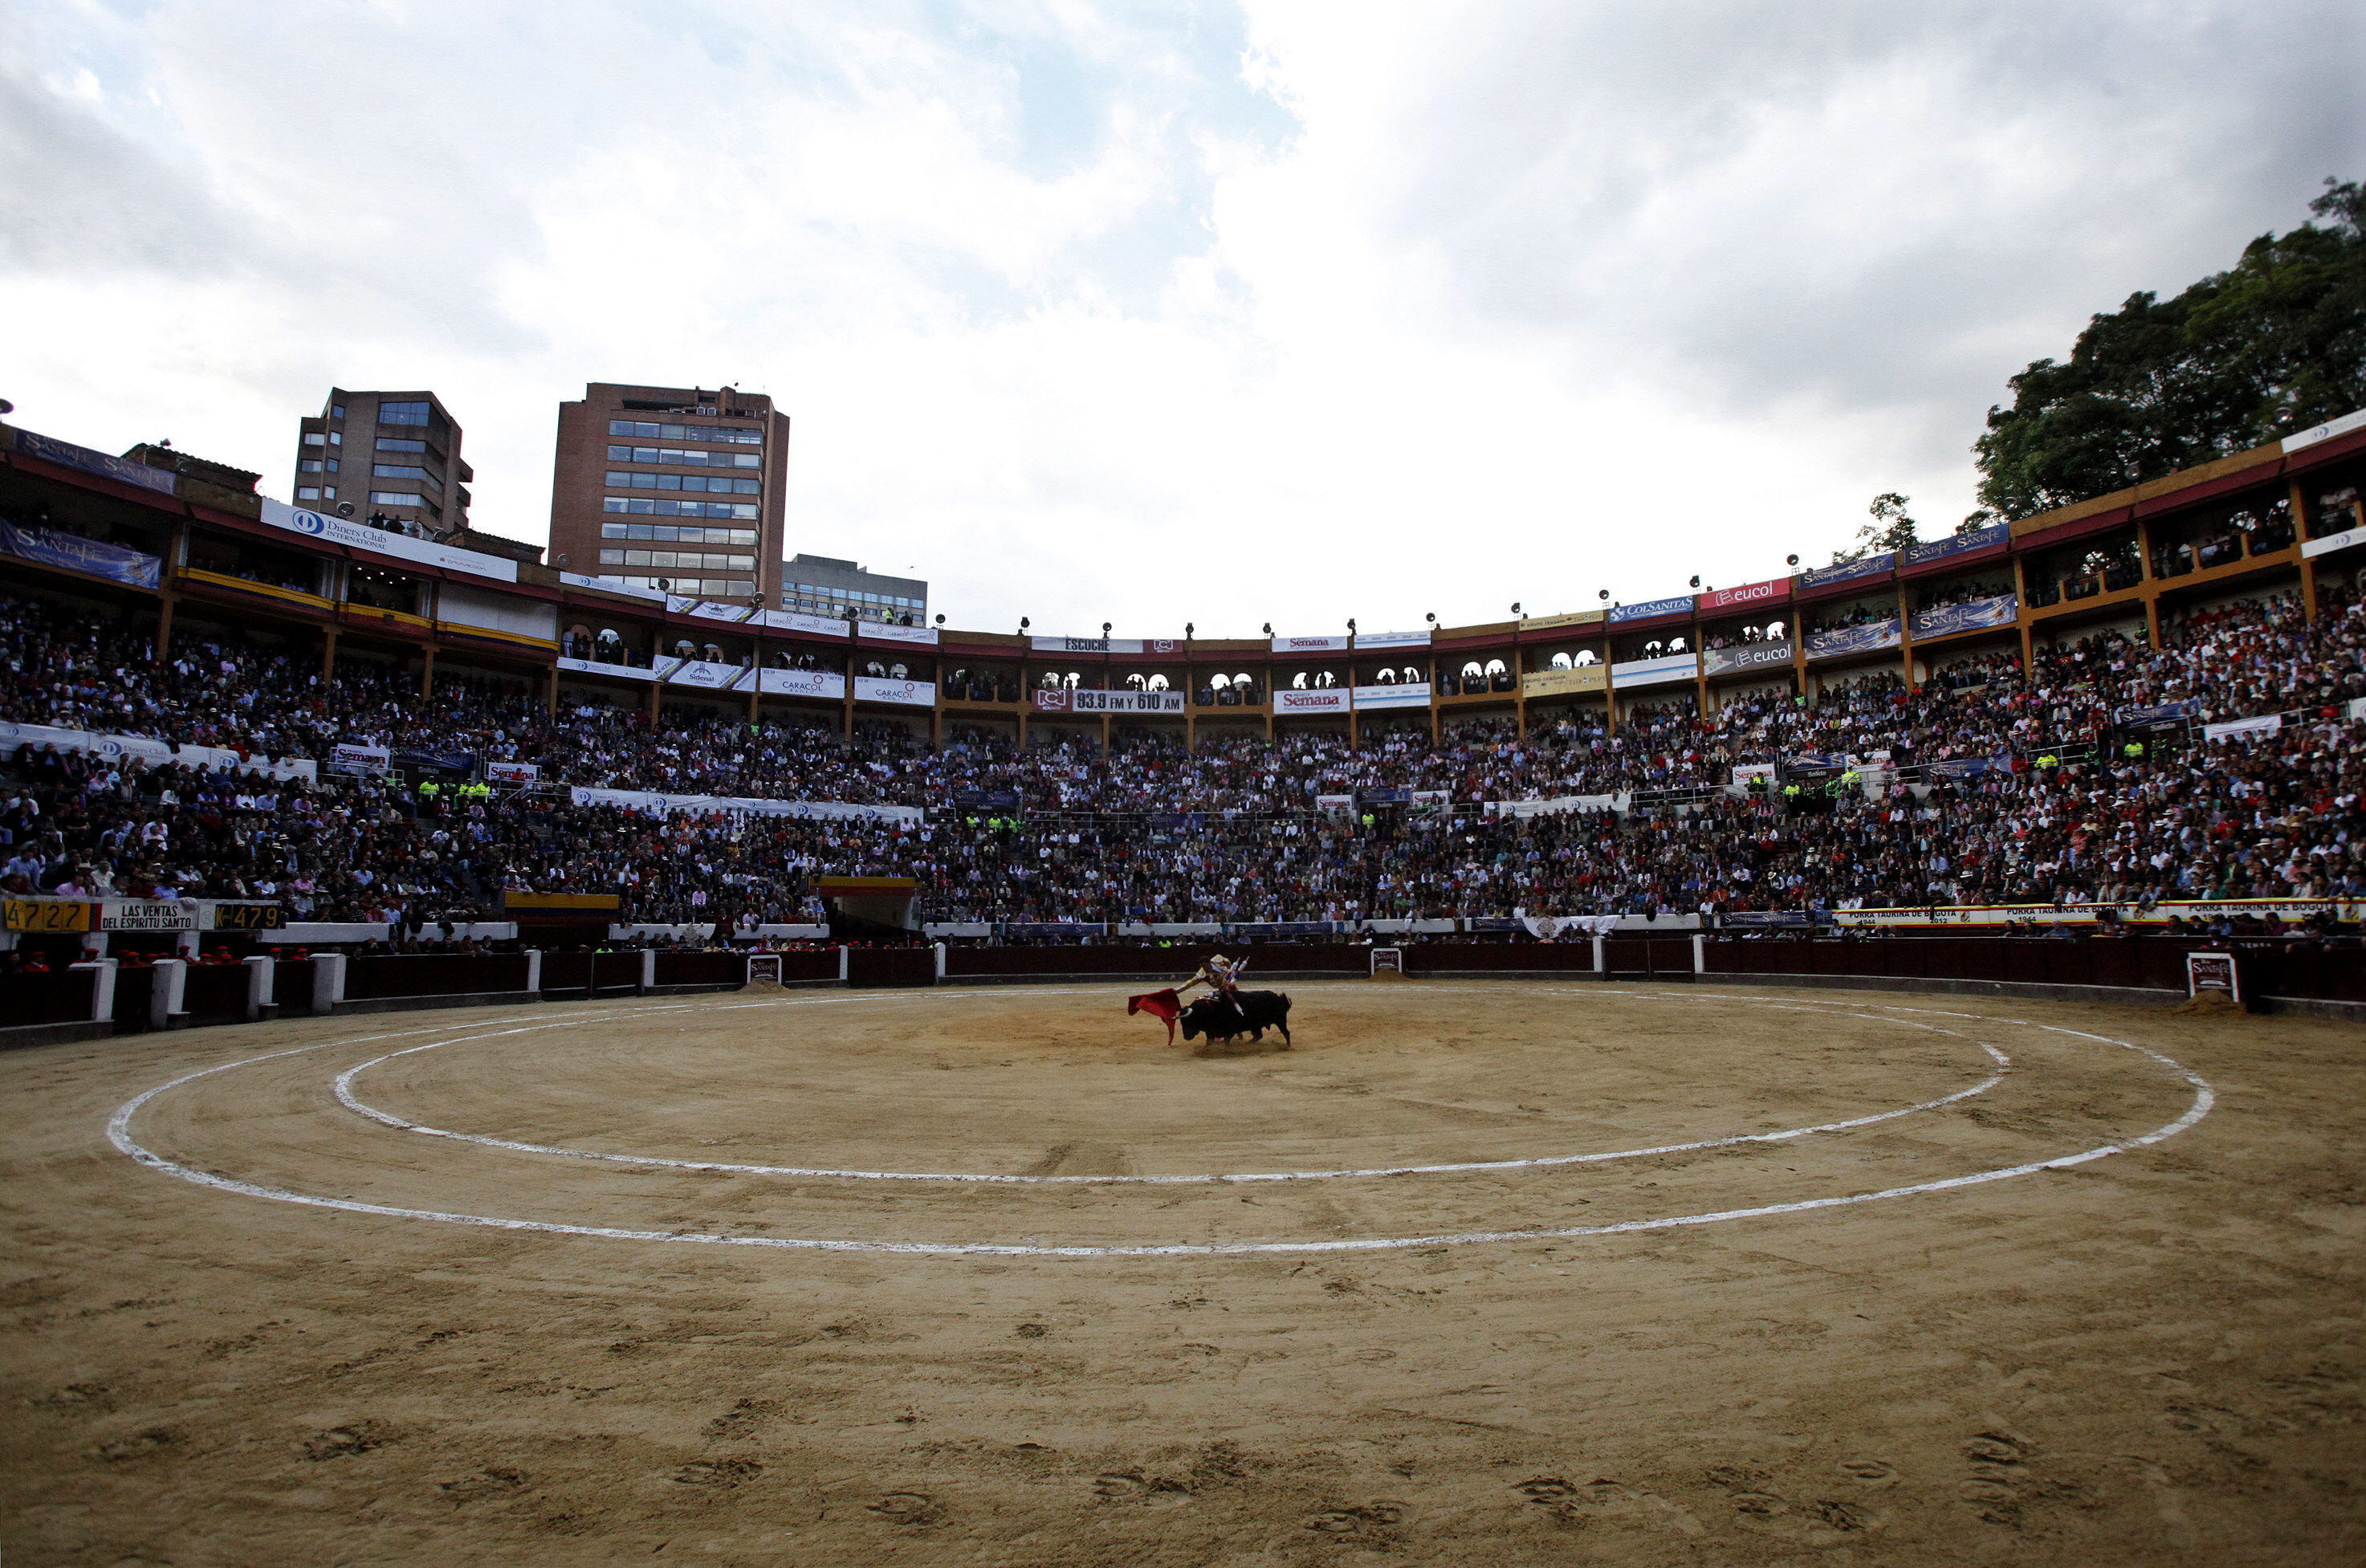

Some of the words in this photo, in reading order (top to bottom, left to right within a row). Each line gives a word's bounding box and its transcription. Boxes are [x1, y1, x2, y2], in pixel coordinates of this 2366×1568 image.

[327, 531, 385, 549] INTERNATIONAL
[363, 530, 387, 543] Club
[1734, 581, 1773, 601] eucol
[1065, 638, 1110, 651] ESCUCHE
[1290, 638, 1330, 647] Semana
[1753, 643, 1791, 663] eucol
[689, 674, 715, 682] Sidenal
[783, 681, 823, 691] CARACOL
[876, 689, 914, 699] CARACOL
[1077, 693, 1106, 709] 93.9
[1110, 698, 1124, 709] FM
[1127, 698, 1134, 709] Y
[1138, 694, 1160, 710] 610
[1164, 698, 1180, 710] AM
[1284, 694, 1340, 707] Semana
[418, 766, 440, 775] Salida
[122, 905, 140, 917] LAS
[143, 905, 178, 917] VENTAS
[2007, 907, 2035, 915] PORRA
[2189, 903, 2223, 912] PORRA
[2226, 902, 2270, 912] TAURINA
[2274, 902, 2289, 911] DE
[103, 918, 117, 929] DEL
[121, 918, 160, 928] ESPIRITU
[162, 918, 191, 928] SANTO
